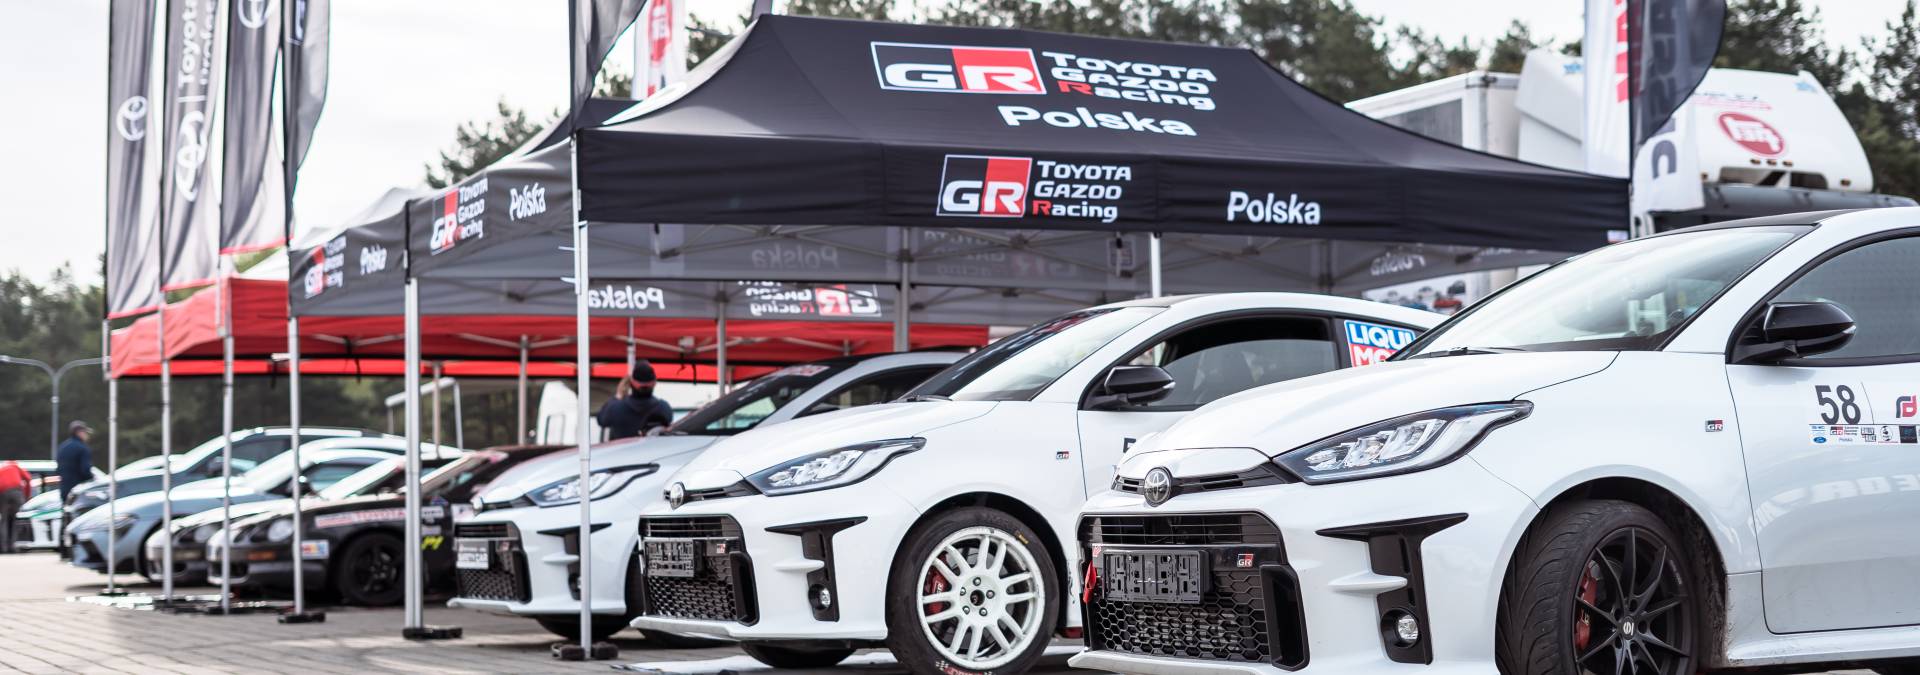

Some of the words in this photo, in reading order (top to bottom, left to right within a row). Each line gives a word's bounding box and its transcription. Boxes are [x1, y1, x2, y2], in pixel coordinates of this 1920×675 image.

[885, 63, 1039, 91] GR
[1042, 51, 1217, 82] TOYOTA
[1051, 67, 1209, 95] GAZOO
[1057, 80, 1216, 111] Racing
[998, 105, 1197, 136] Polska
[1037, 160, 1132, 181] TOYOTA
[459, 178, 488, 204] TOYOTA
[509, 182, 547, 221] Polska
[942, 180, 1025, 213] GR
[1034, 181, 1122, 200] GAZOO
[458, 199, 485, 223] GAZOO
[1032, 200, 1118, 223] Racing
[1226, 191, 1322, 225] Polska
[430, 214, 457, 250] GR
[455, 219, 484, 242] Racing
[1348, 324, 1414, 350] LIQUI
[1815, 385, 1861, 425] 58
[1238, 559, 1252, 567] GR
